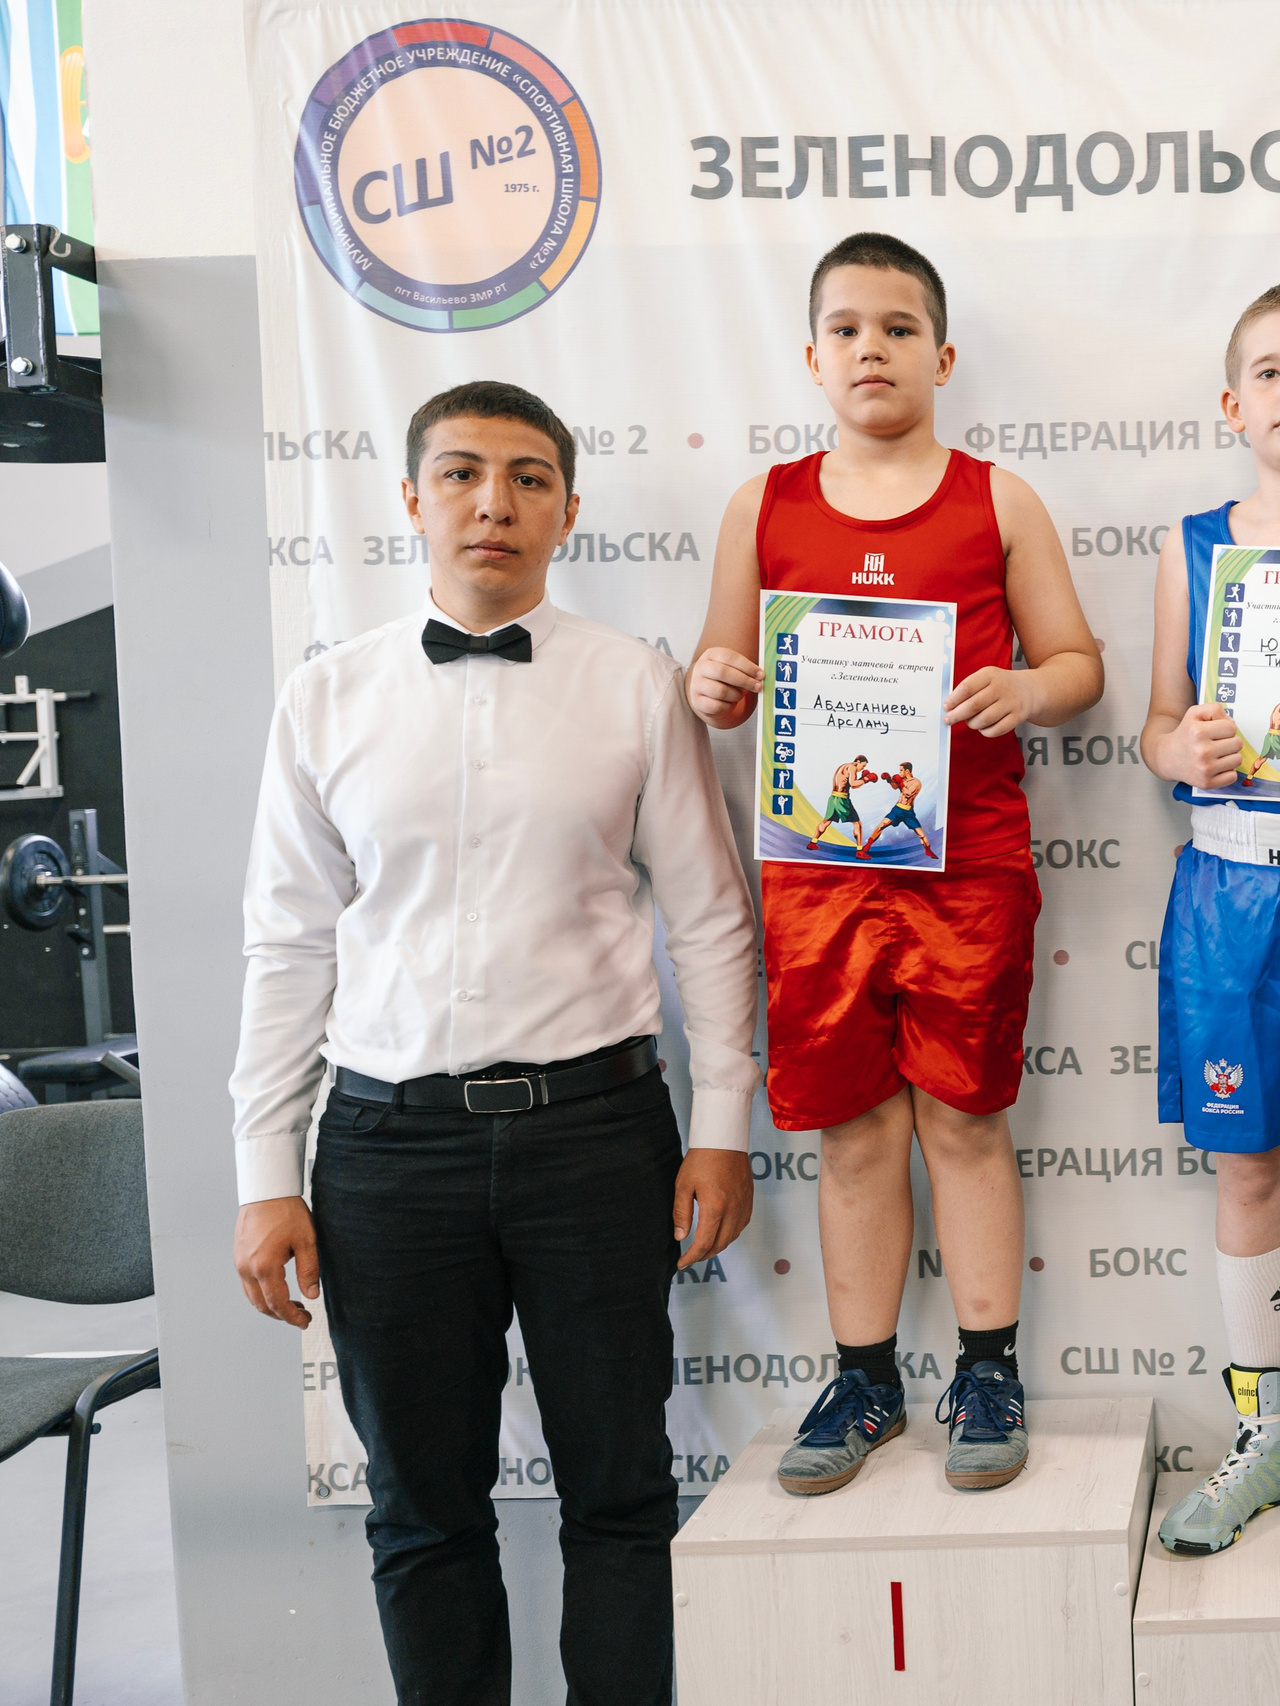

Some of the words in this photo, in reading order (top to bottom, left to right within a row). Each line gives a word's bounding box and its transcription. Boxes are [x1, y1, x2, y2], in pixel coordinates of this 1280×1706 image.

[408, 47, 512, 78] УЧРЕЖДЕНИЕ
[328, 54, 405, 131] БЮДЖЕТНОЕ
[513, 73, 574, 174] «СПОРТИВНАЯ
[352, 150, 455, 225] СШ
[469, 124, 537, 170] №2
[504, 183, 530, 193] 1975
[531, 185, 540, 193] г.
[320, 130, 373, 271] МУНИЦИПАЛЬНОЕ
[550, 178, 574, 235] ШКОЛА
[529, 237, 558, 270] №2»
[394, 286, 411, 297] пгт
[413, 291, 468, 304] Васильево
[469, 289, 493, 303] ЗМР
[494, 282, 507, 295] РТ
[628, 424, 649, 455] 2
[964, 420, 1200, 460] ФЕДЕРАЦИЯ
[851, 571, 895, 586] HUKK
[818, 621, 924, 644] ГРАМОТА
[801, 655, 850, 668] Участнику
[850, 660, 894, 670] матчевой
[898, 664, 935, 673] встречи
[830, 672, 900, 684] г.Зеленодольск
[1089, 1246, 1188, 1278] БОКС
[1061, 1346, 1120, 1376] СШ
[1133, 1347, 1175, 1377] №
[1187, 1345, 1208, 1376] 2
